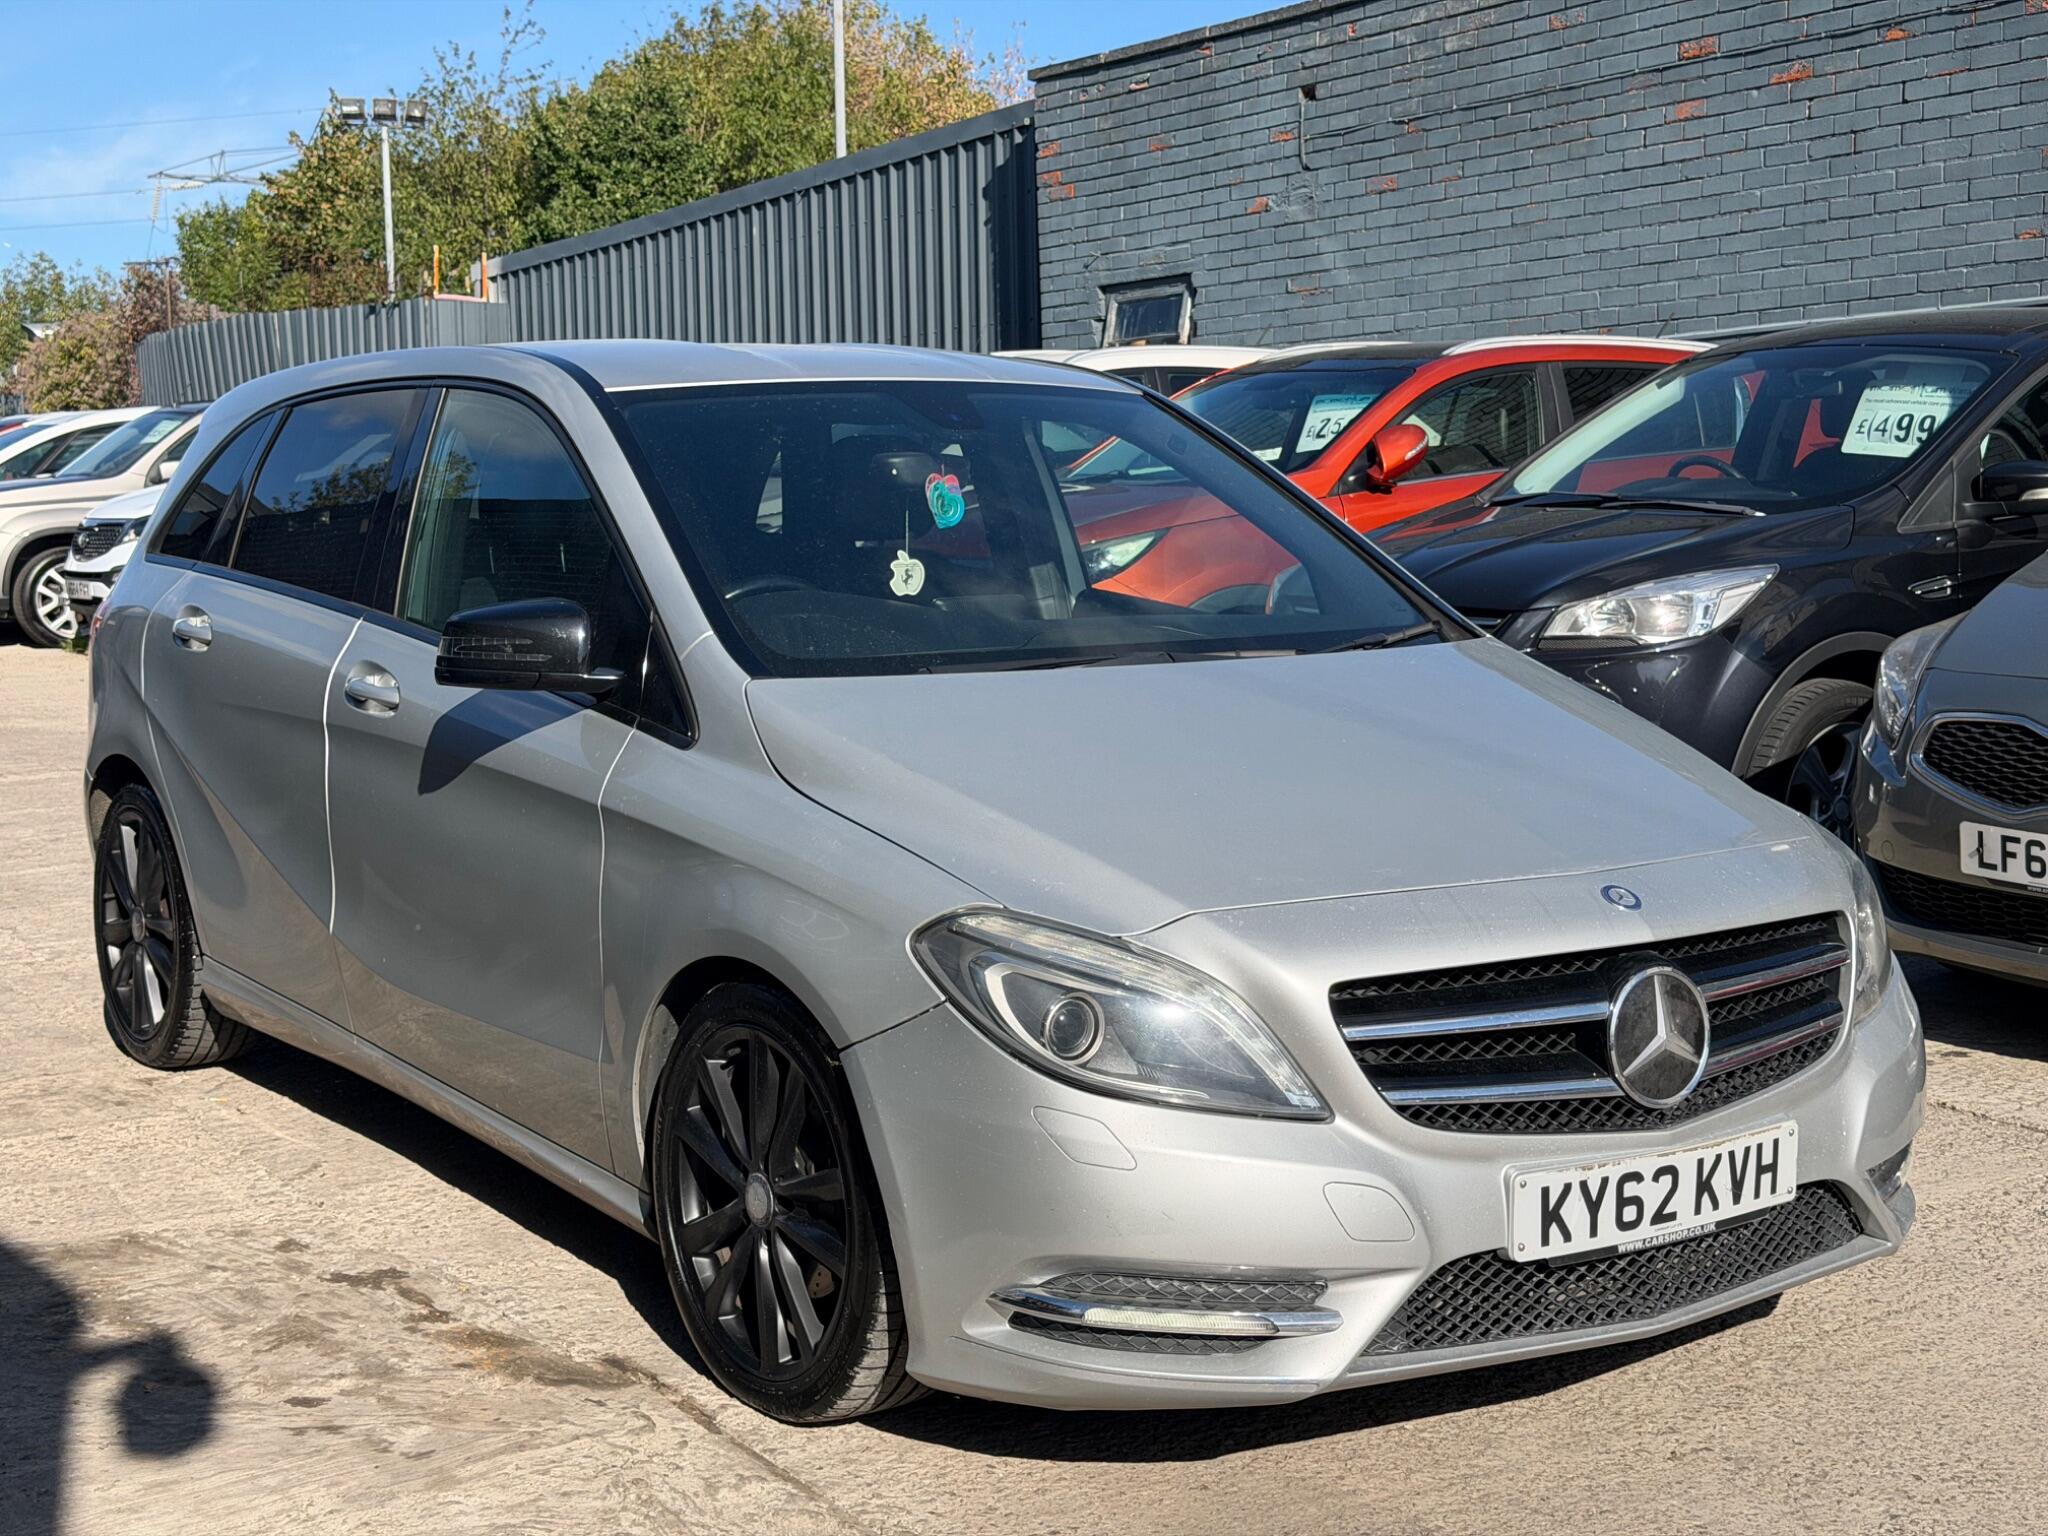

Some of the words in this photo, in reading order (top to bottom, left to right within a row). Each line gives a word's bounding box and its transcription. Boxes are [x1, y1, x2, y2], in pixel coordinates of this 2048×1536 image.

[1977, 830, 2047, 879] LF6
[1540, 1164, 1680, 1247] KY62
[1693, 1137, 1780, 1216] KVH
[1617, 1222, 1716, 1253] WWW.CARSHOP.CO.UK
